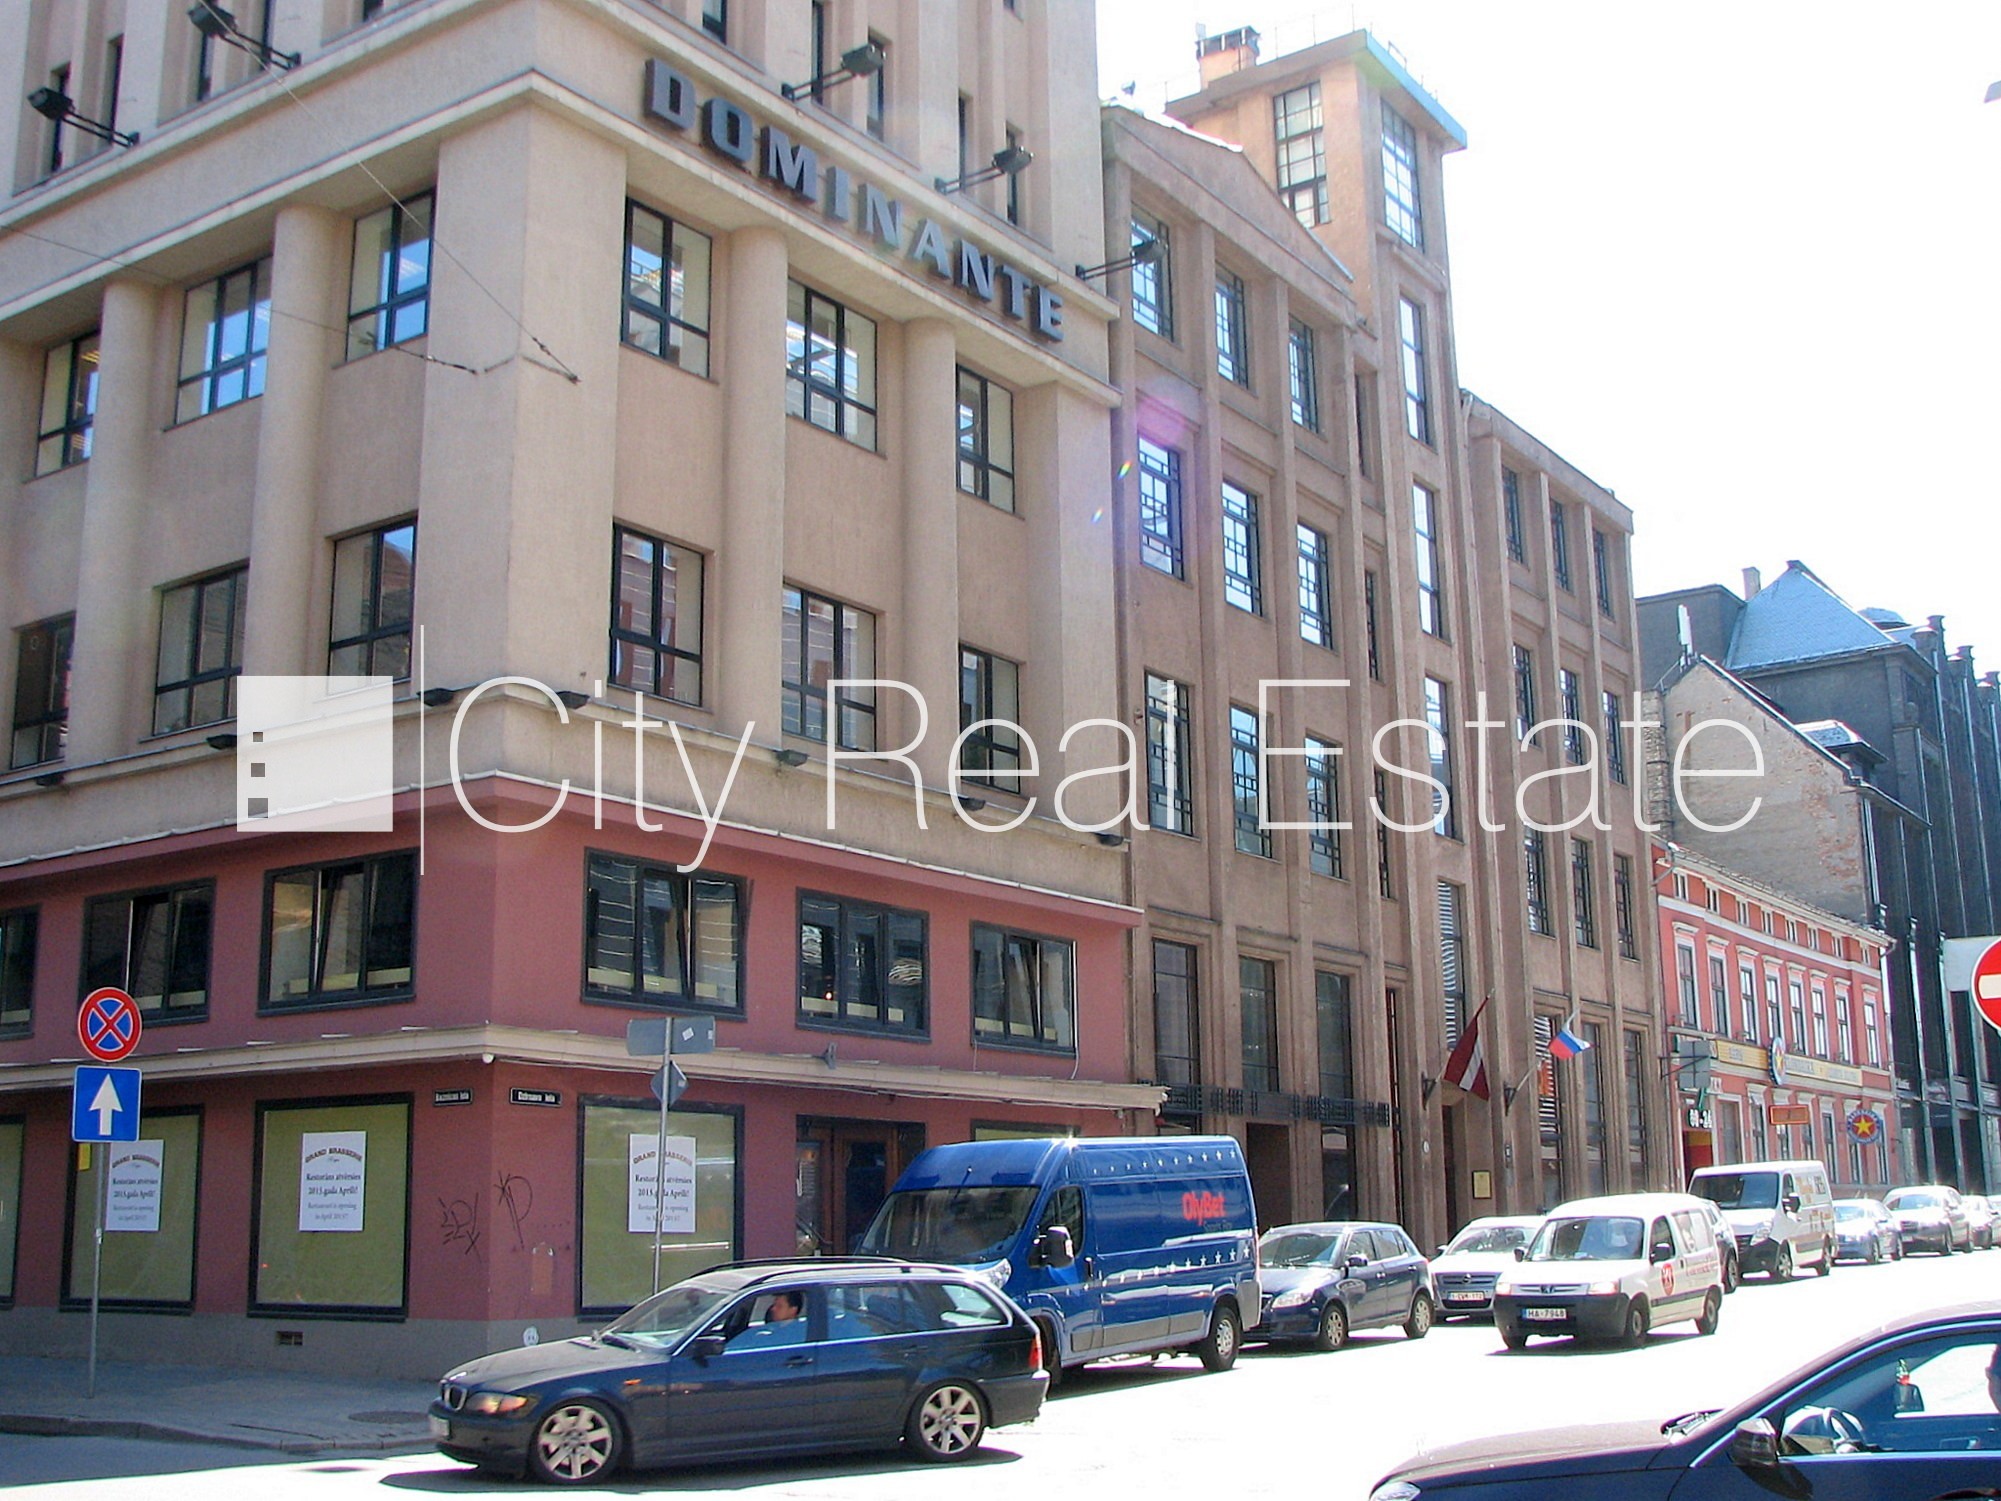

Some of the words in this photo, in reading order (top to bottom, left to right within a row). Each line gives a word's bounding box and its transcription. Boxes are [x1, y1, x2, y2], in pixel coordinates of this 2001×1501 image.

[644, 57, 1064, 343] DOMINANTE
[633, 1151, 656, 1164] GRAND
[1182, 1191, 1227, 1226] OlyBet
